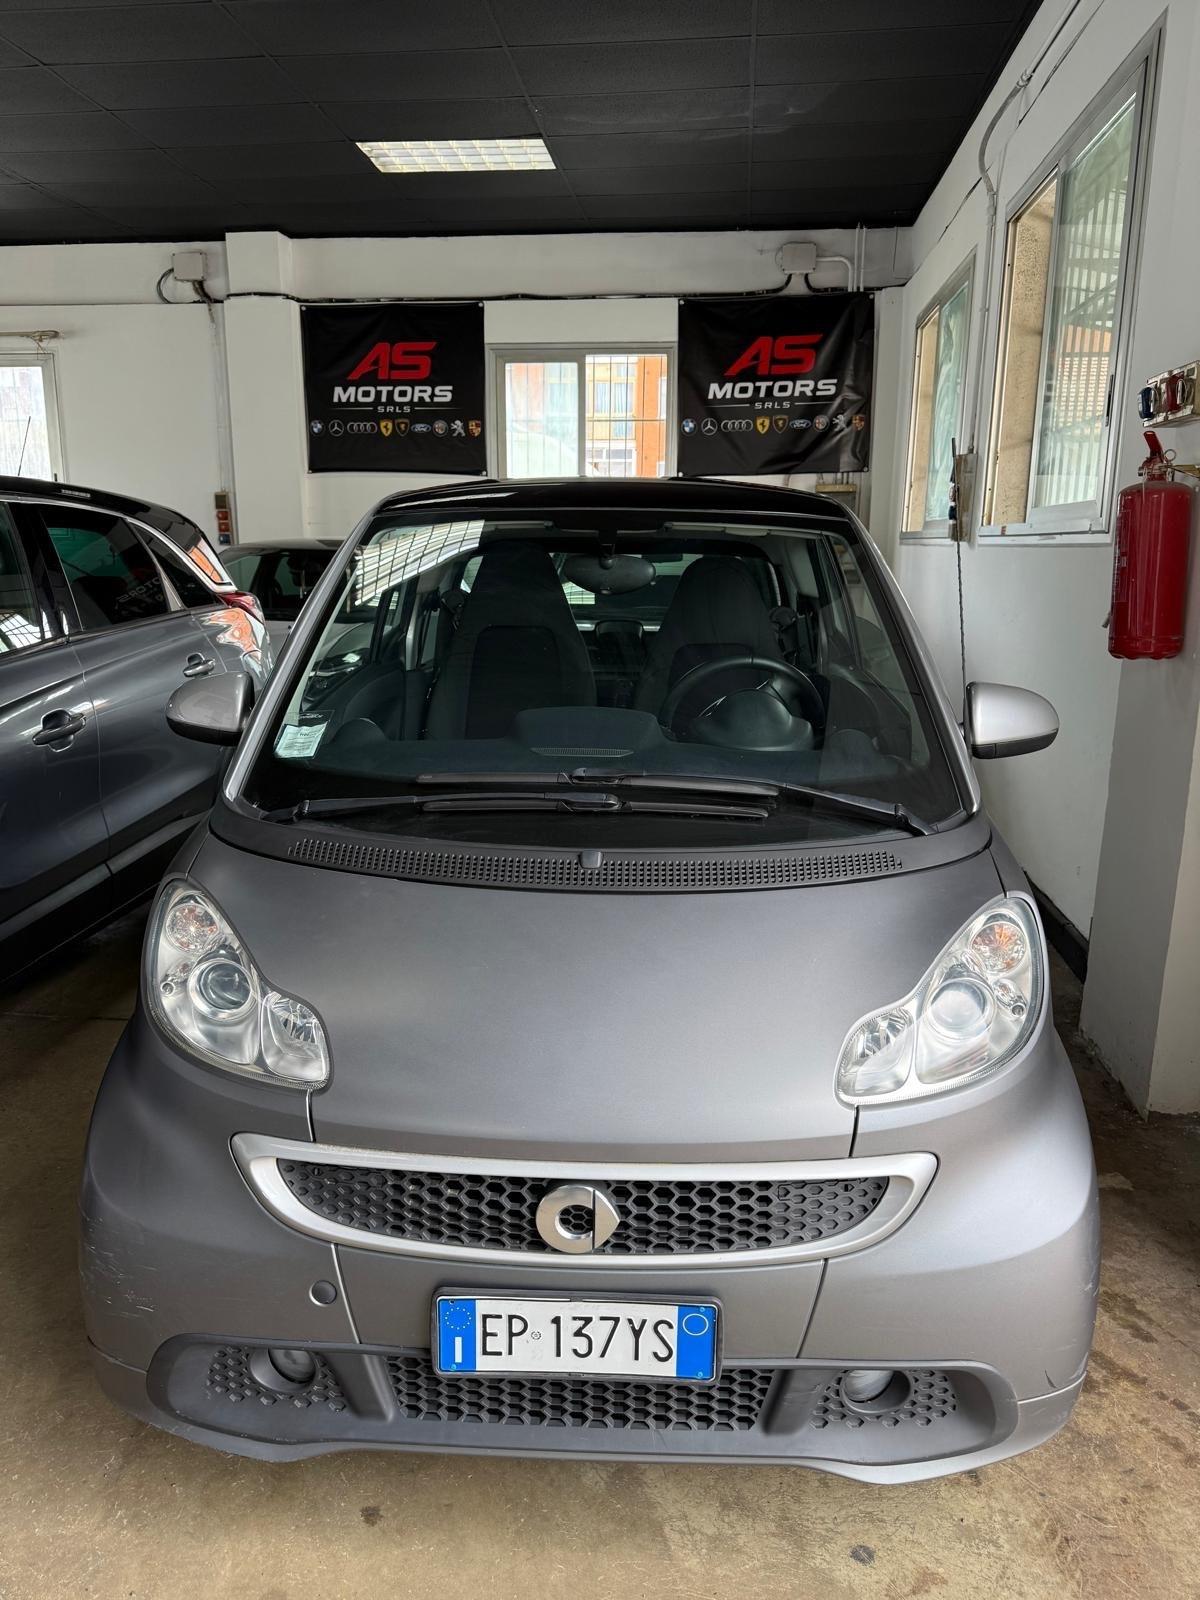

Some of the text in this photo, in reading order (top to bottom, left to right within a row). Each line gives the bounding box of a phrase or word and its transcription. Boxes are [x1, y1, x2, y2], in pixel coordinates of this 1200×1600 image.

[346, 341, 438, 381] AS
[723, 333, 824, 377] AS
[332, 385, 453, 403] MOTORS
[707, 379, 838, 400] MOTORS
[377, 405, 411, 413] SRLS
[754, 401, 791, 410] SRLS
[454, 1336, 462, 1363] I
[481, 1313, 674, 1363] EP 137YS
